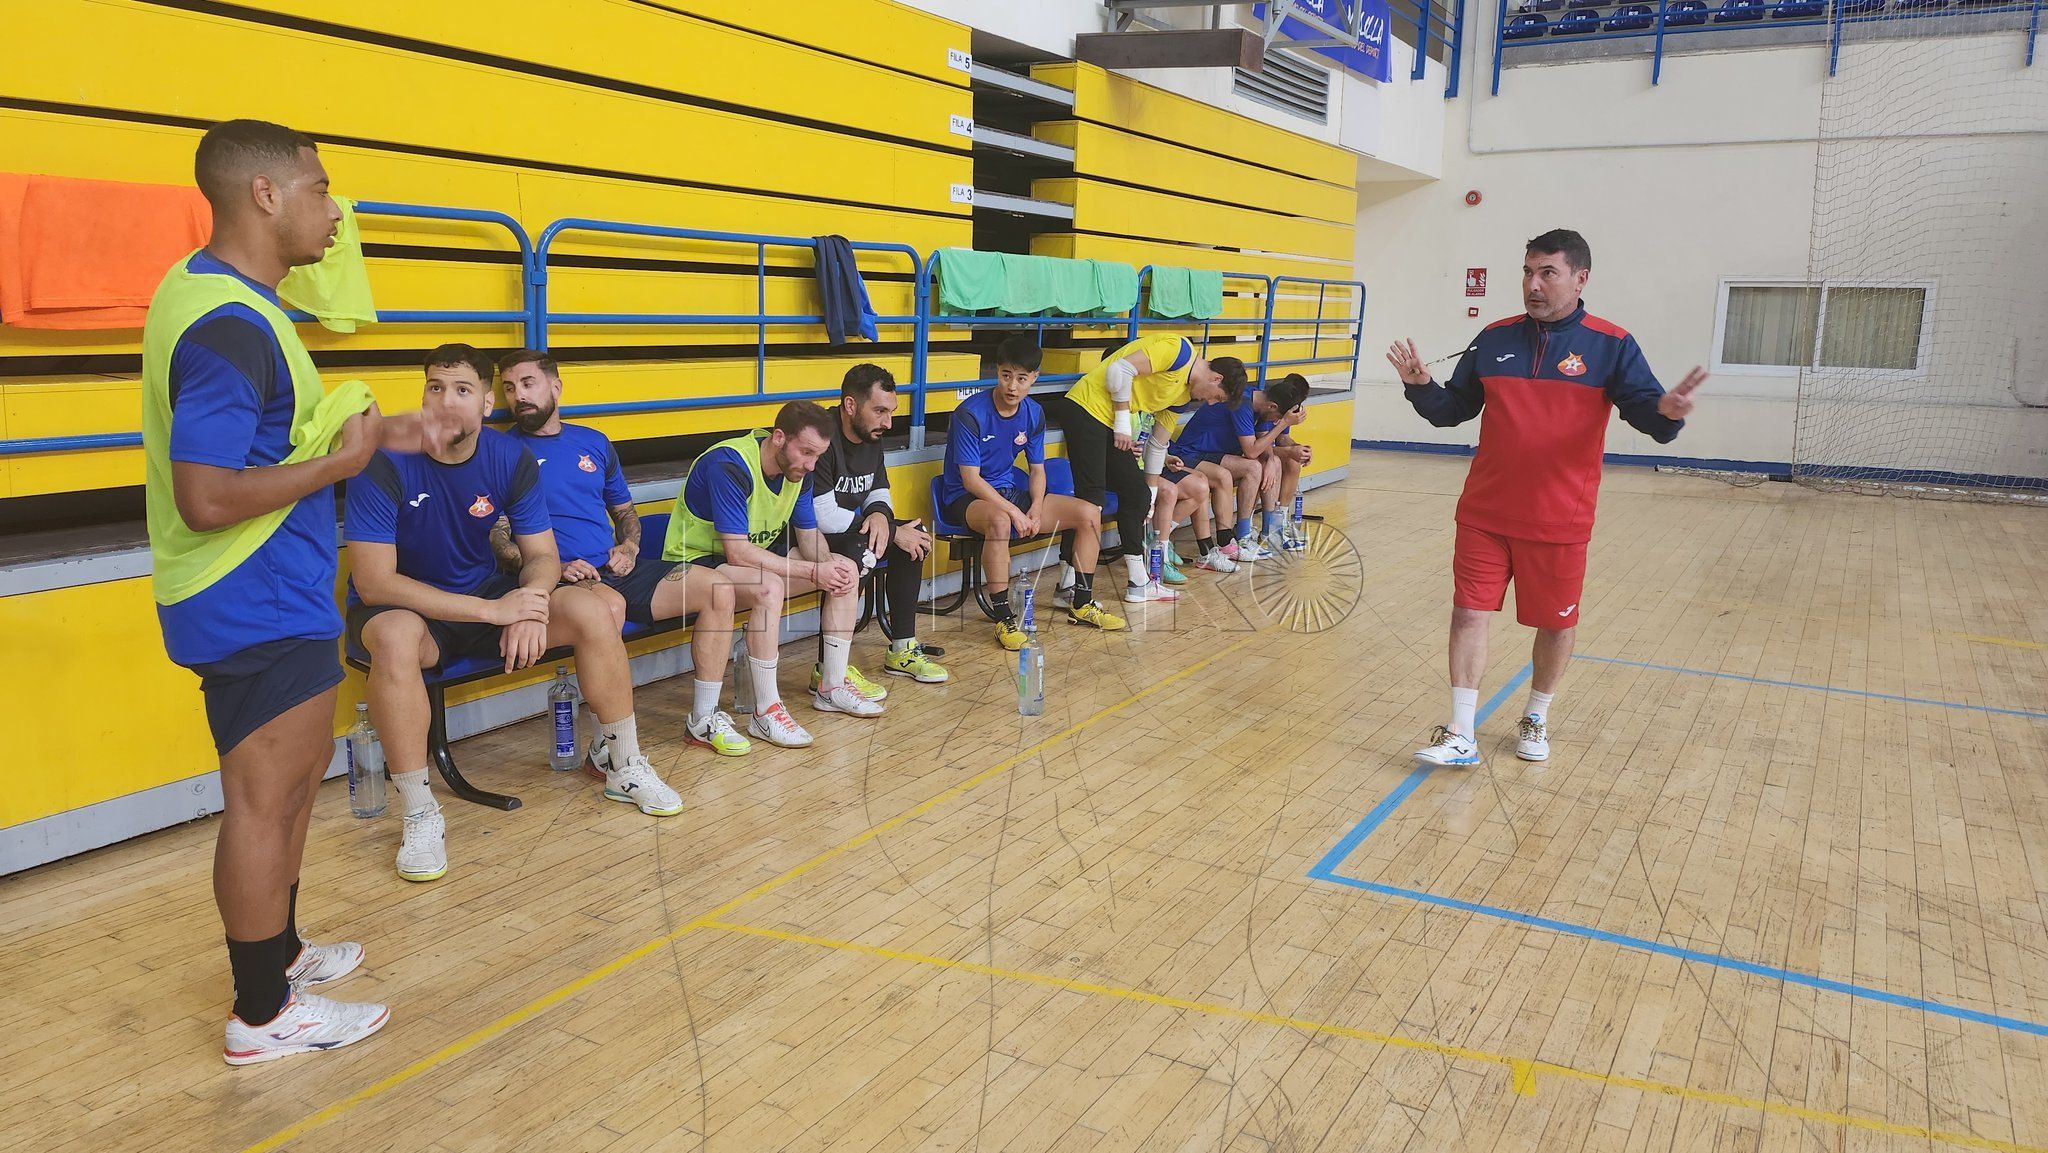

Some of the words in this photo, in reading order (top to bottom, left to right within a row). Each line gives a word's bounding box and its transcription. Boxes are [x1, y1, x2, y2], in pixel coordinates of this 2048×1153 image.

[950, 51, 963, 63] FILA
[964, 57, 970, 69] 5
[952, 117, 964, 128] FILA
[966, 122, 972, 134] 4
[952, 186, 965, 196] FILA
[966, 189, 973, 201] 3
